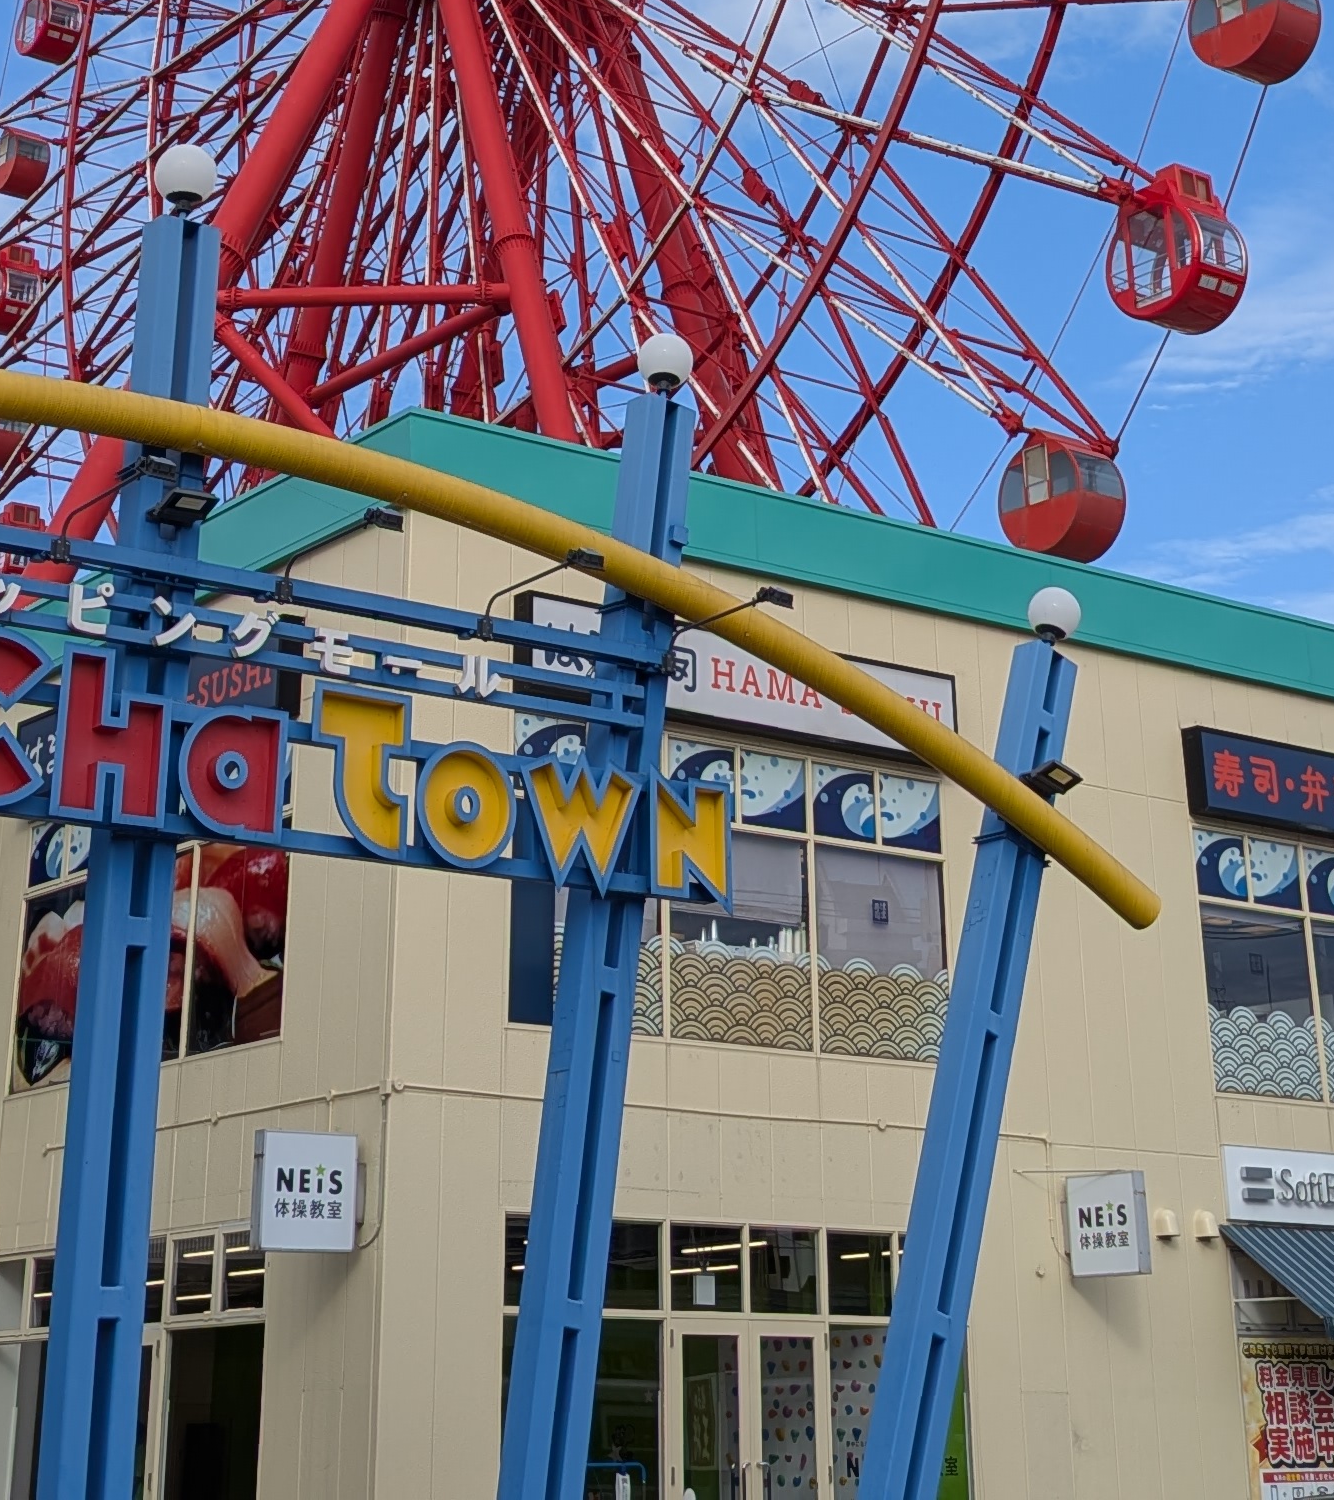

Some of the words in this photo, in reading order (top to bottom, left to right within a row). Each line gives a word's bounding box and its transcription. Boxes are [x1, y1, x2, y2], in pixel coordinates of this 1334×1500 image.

[273, 1199, 343, 1220] 体操教室
[1079, 1230, 1130, 1251] 体操教室
